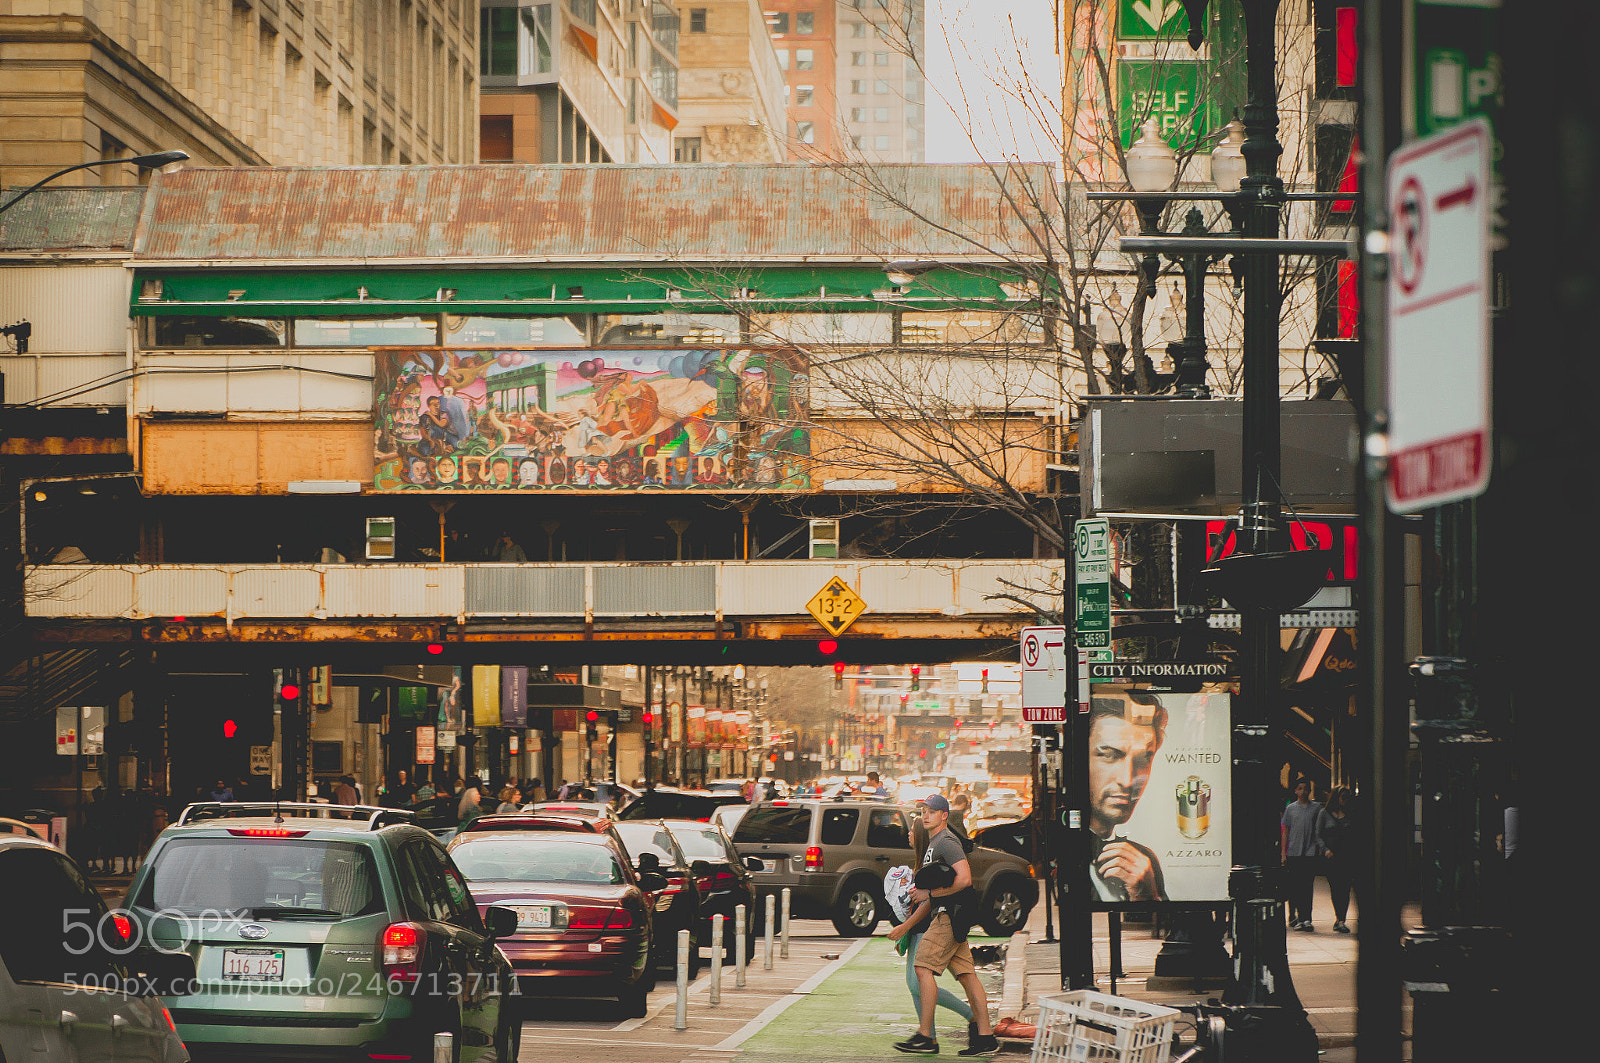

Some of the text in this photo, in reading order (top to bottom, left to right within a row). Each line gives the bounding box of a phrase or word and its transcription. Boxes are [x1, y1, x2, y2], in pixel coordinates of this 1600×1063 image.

[1132, 90, 1188, 112] SELF
[1132, 113, 1196, 135] PRK
[1093, 664, 1227, 676] CITY INFORMATION
[1027, 708, 1062, 720] TOW ZONE
[1165, 753, 1221, 764] WANTED
[1166, 850, 1222, 858] AZZARO
[229, 959, 278, 974] 116 125
